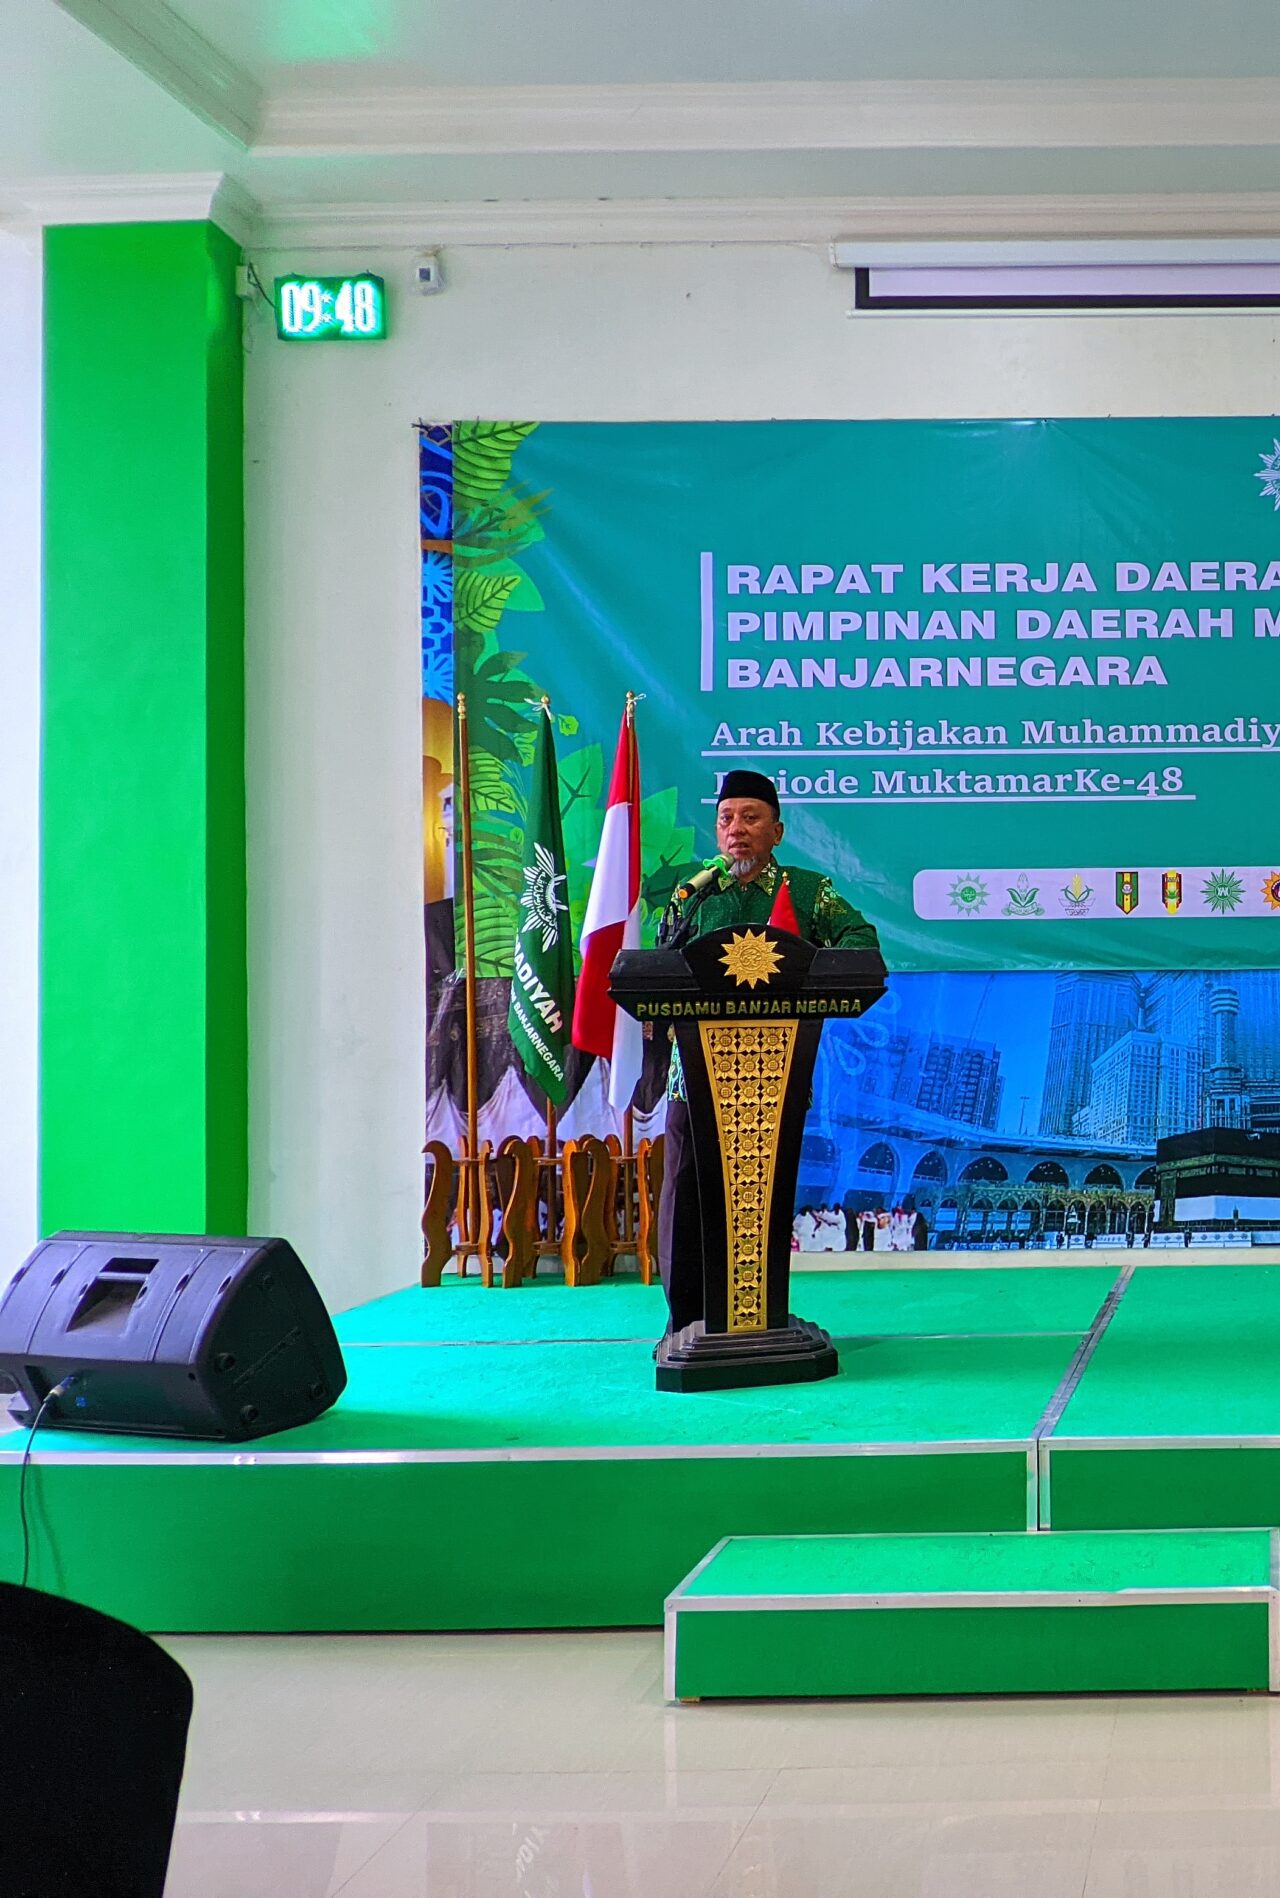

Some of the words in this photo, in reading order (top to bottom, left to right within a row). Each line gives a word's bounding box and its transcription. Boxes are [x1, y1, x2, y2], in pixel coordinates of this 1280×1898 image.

[280, 282, 376, 333] 09:48
[727, 564, 904, 595] RAPAT
[922, 562, 1098, 594] KERJA
[727, 610, 996, 642] PIMPINAN
[1016, 608, 1233, 640] DAERAH
[727, 656, 1168, 689] BANJARNEGARA
[711, 721, 802, 747] Arah
[816, 719, 1008, 752] Kebijakan
[637, 1001, 721, 1017] PUSDAMU
[725, 1000, 791, 1015] BANJAR
[795, 999, 862, 1014] NEGARA
[513, 1001, 564, 1082] BANJARNEGARA
